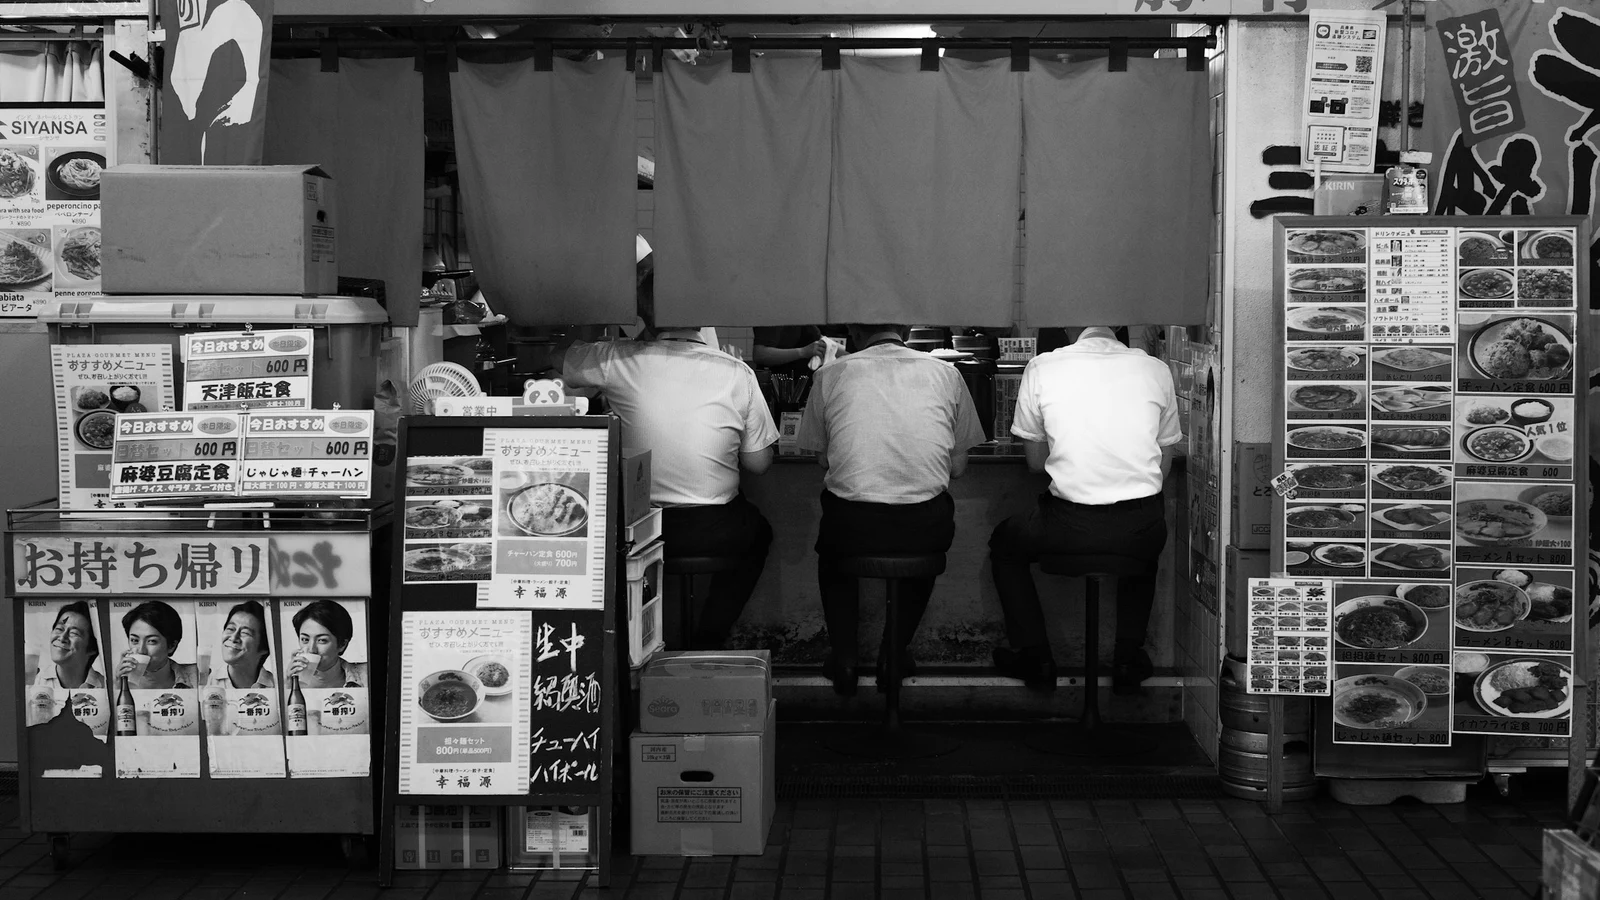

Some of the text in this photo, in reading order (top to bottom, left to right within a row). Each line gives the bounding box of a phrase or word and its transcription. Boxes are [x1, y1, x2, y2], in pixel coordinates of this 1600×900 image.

[1443, 20, 1514, 134] 激旨
[11, 121, 88, 135] SIYANSA
[1325, 181, 1355, 190] KIRIN
[46, 202, 92, 210] peperoncino
[191, 339, 264, 354] 今日おすすめ
[67, 360, 156, 372] おすすめメニュー
[266, 359, 308, 373] 600円
[201, 381, 292, 401] 天津飯定食
[1462, 381, 1536, 392] チャハン定食
[121, 420, 193, 434] 今日おすすめ
[250, 418, 324, 431] 今日おすすめ
[1526, 421, 1567, 437] 人気1位
[194, 441, 237, 456] 600円
[326, 440, 369, 456] 600円
[500, 445, 591, 457] おすすめメニュー
[120, 463, 231, 483] 麻婆豆腐定食
[1466, 465, 1559, 477] 麻婆豆腐定食 600
[555, 550, 578, 558] 600円
[1549, 553, 1566, 564] 800
[18, 541, 262, 590] お持ち帰り
[514, 586, 567, 599] 幸福源
[419, 627, 514, 640] おすすめメニュー
[536, 622, 586, 672] 生中
[1549, 639, 1566, 649] 800
[152, 707, 185, 717] 一番搾り
[238, 707, 270, 716] 一番搾り
[323, 706, 356, 716] 一番搾り
[648, 704, 678, 713] Seara
[1459, 719, 1568, 733] イカフライ定食 700円
[531, 727, 600, 754] チューハイ
[1429, 733, 1447, 743] 800
[435, 775, 493, 789] 幸福源
